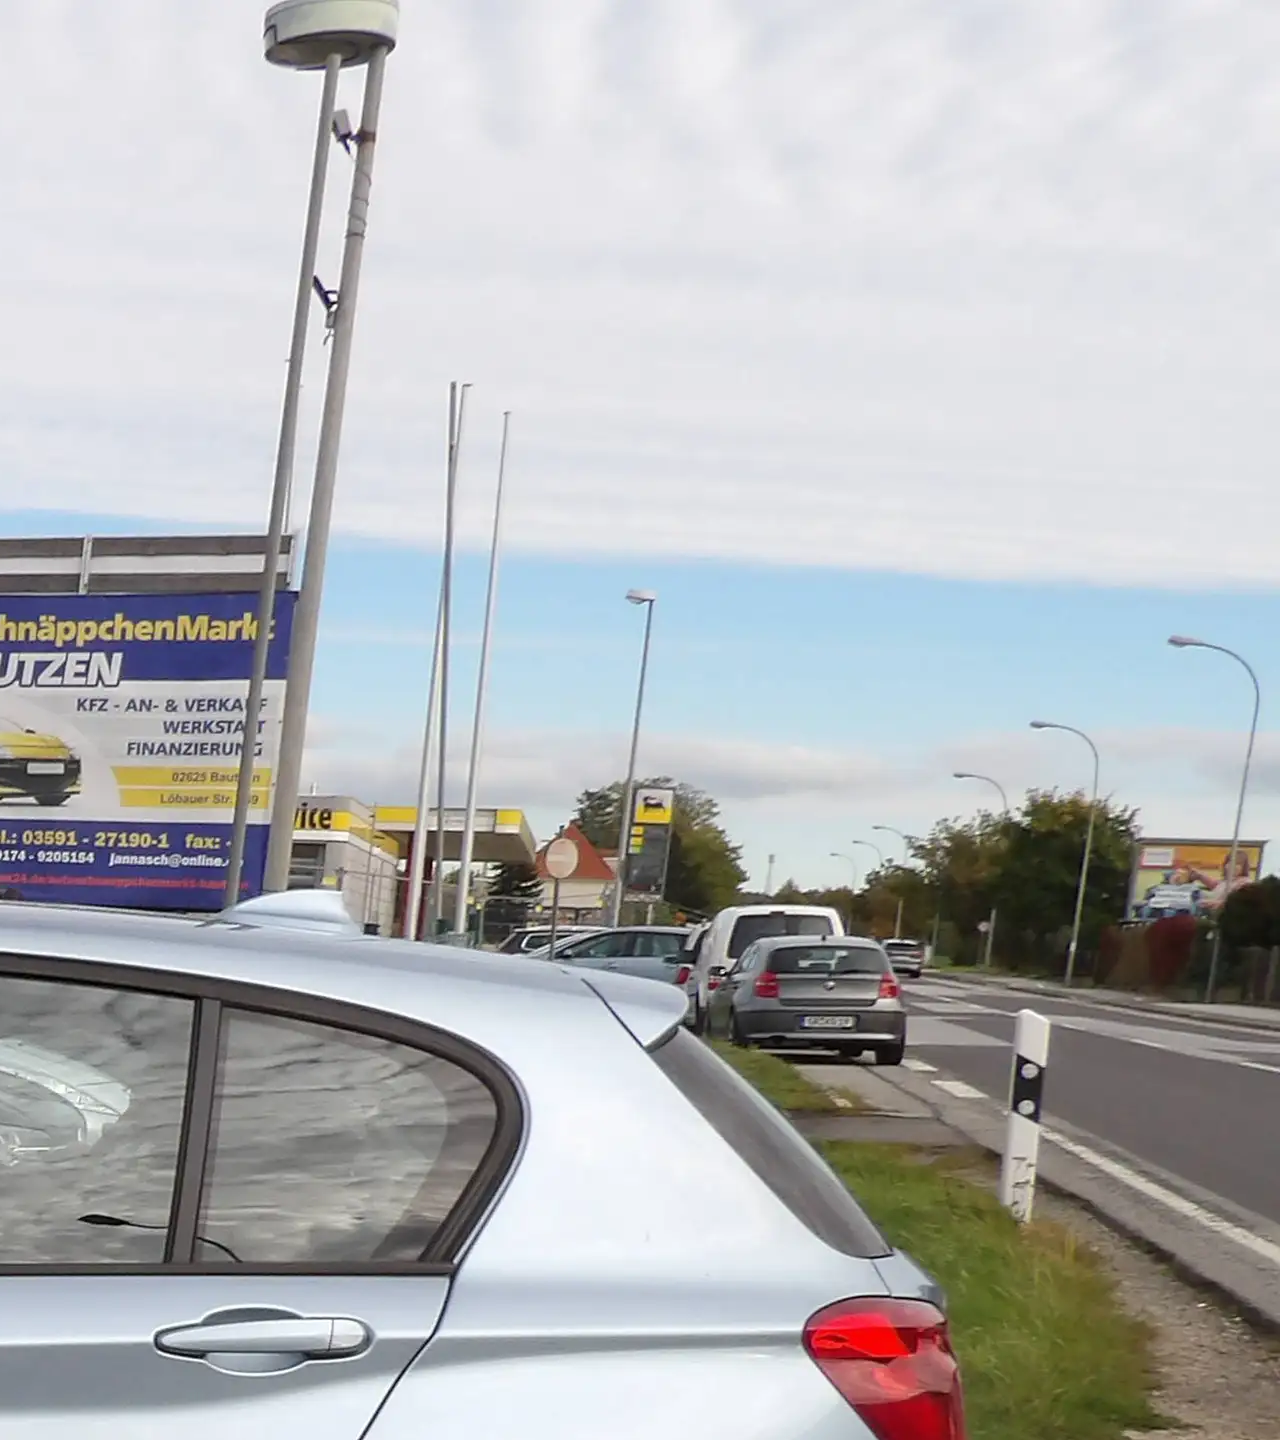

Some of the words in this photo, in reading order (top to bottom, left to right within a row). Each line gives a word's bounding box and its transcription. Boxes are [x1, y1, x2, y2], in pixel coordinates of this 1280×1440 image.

[76, 698, 108, 712] KFZ
[124, 699, 159, 712] AN-
[165, 699, 178, 712] &
[185, 698, 268, 713] VERKAF
[163, 720, 266, 735] WERKSTAT
[209, 771, 261, 783] Bautn
[212, 794, 233, 805] Str.
[22, 829, 78, 847] 03591
[93, 831, 170, 849] 27190-1
[184, 833, 221, 849] fax:
